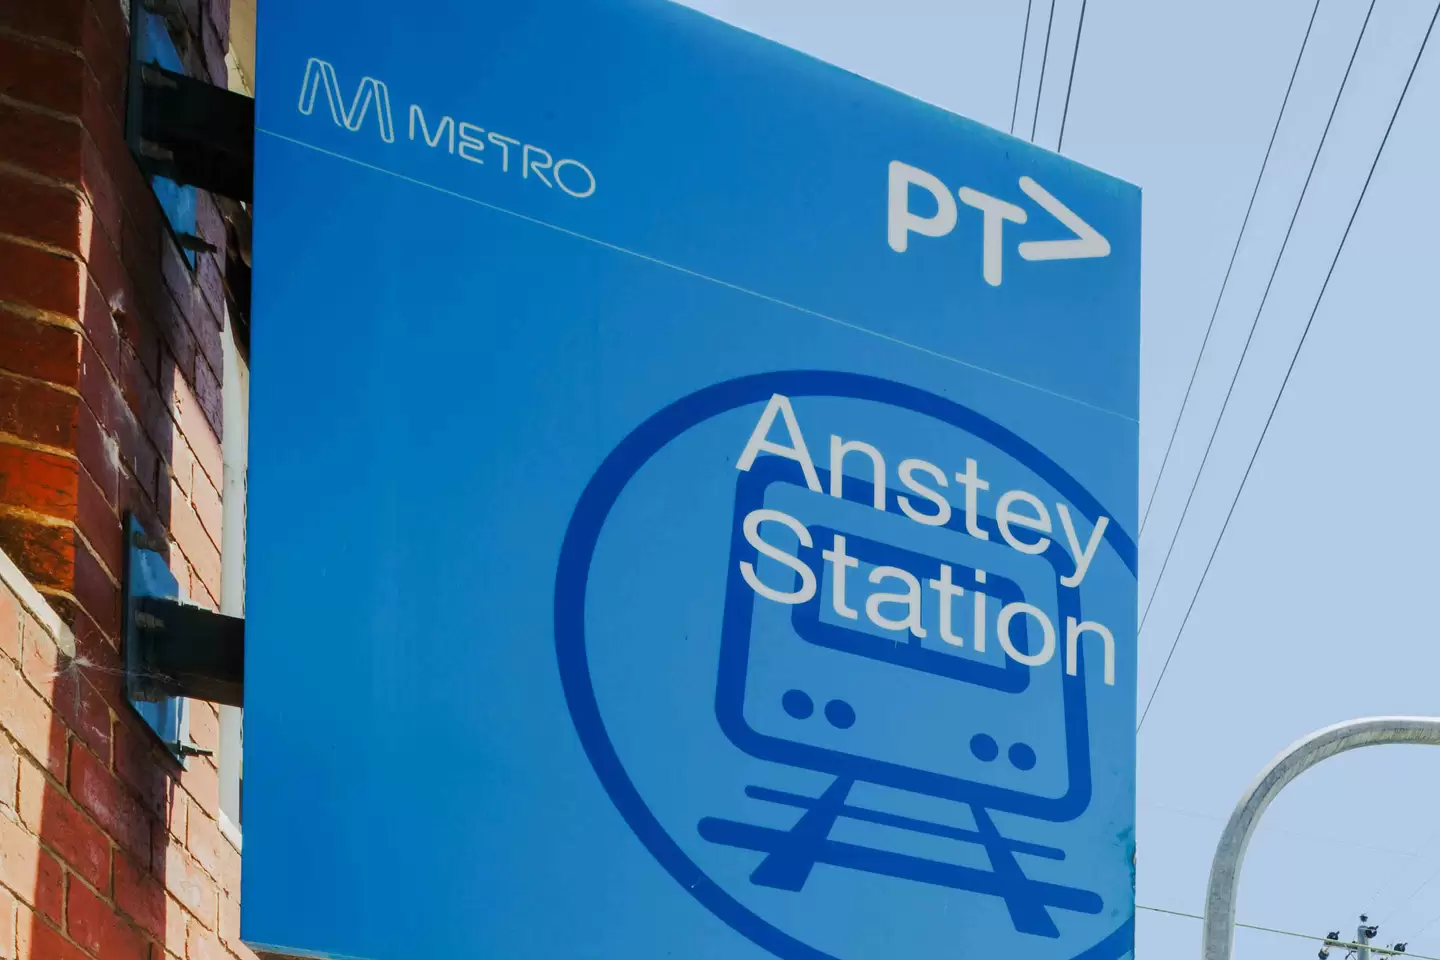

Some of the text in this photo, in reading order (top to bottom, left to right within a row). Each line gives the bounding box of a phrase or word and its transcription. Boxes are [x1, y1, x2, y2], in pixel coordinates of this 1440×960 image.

[409, 104, 597, 198] METRO
[736, 393, 1110, 587] Anstey
[739, 509, 1117, 686] Station
